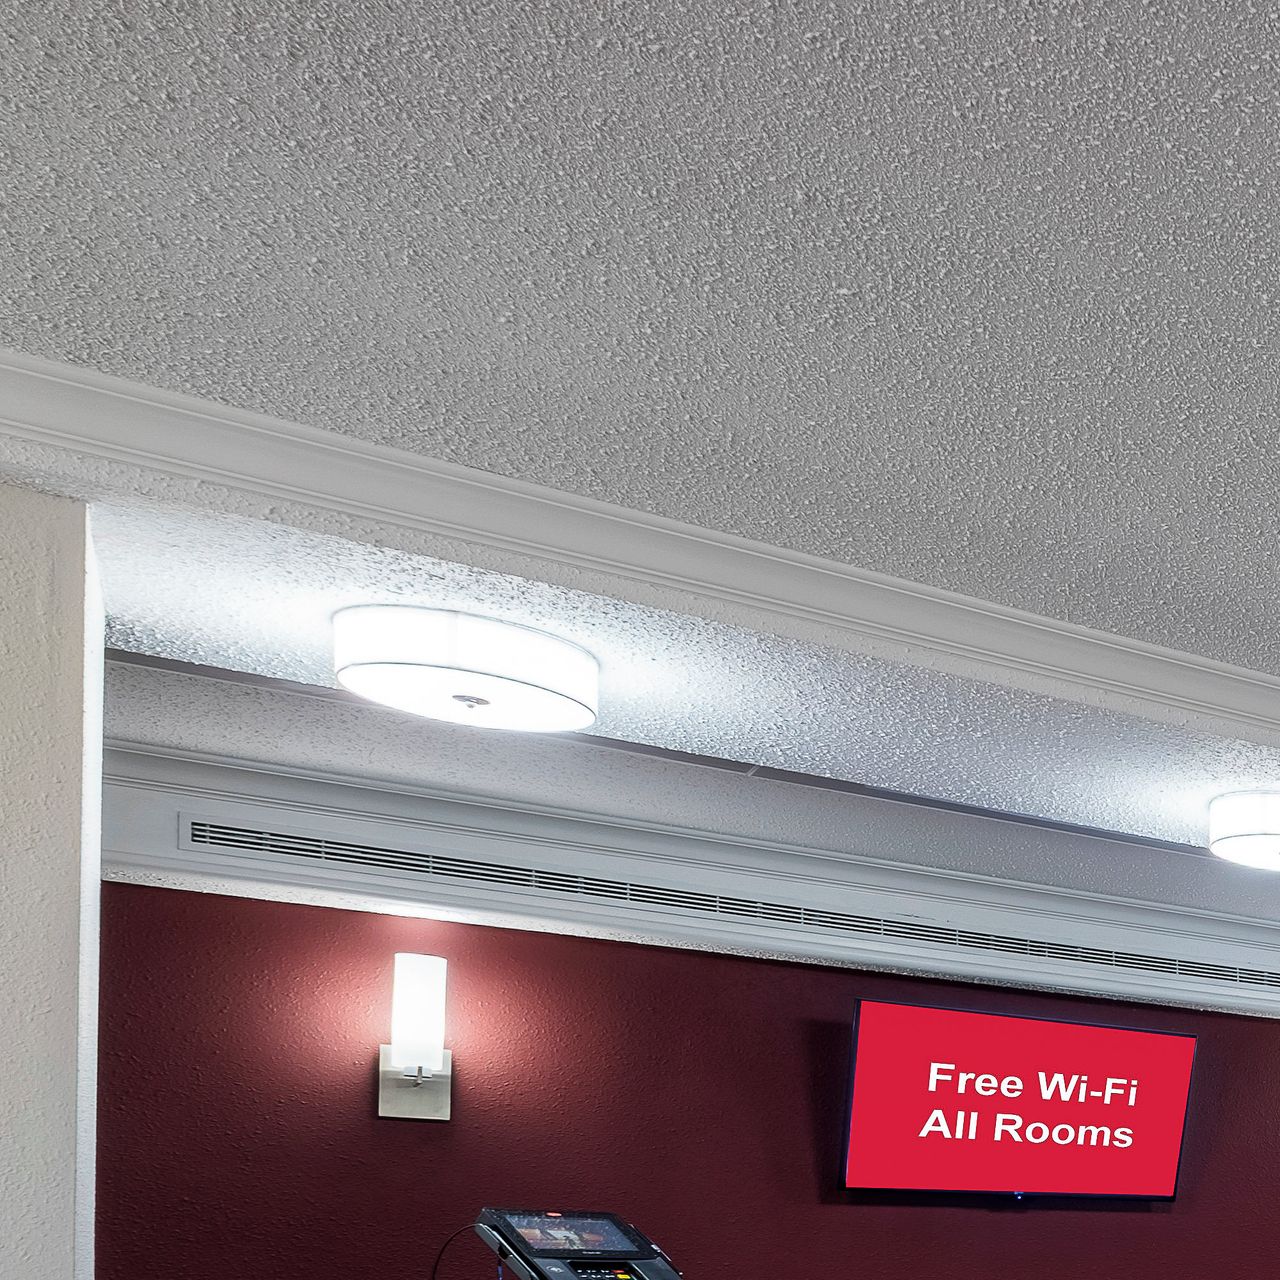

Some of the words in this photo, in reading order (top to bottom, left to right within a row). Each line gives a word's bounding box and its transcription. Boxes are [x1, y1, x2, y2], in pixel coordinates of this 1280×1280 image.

[927, 1062, 1024, 1098] Free
[1037, 1071, 1138, 1106] Wi-Fi
[918, 1109, 978, 1140] All
[994, 1113, 1134, 1148] Rooms
